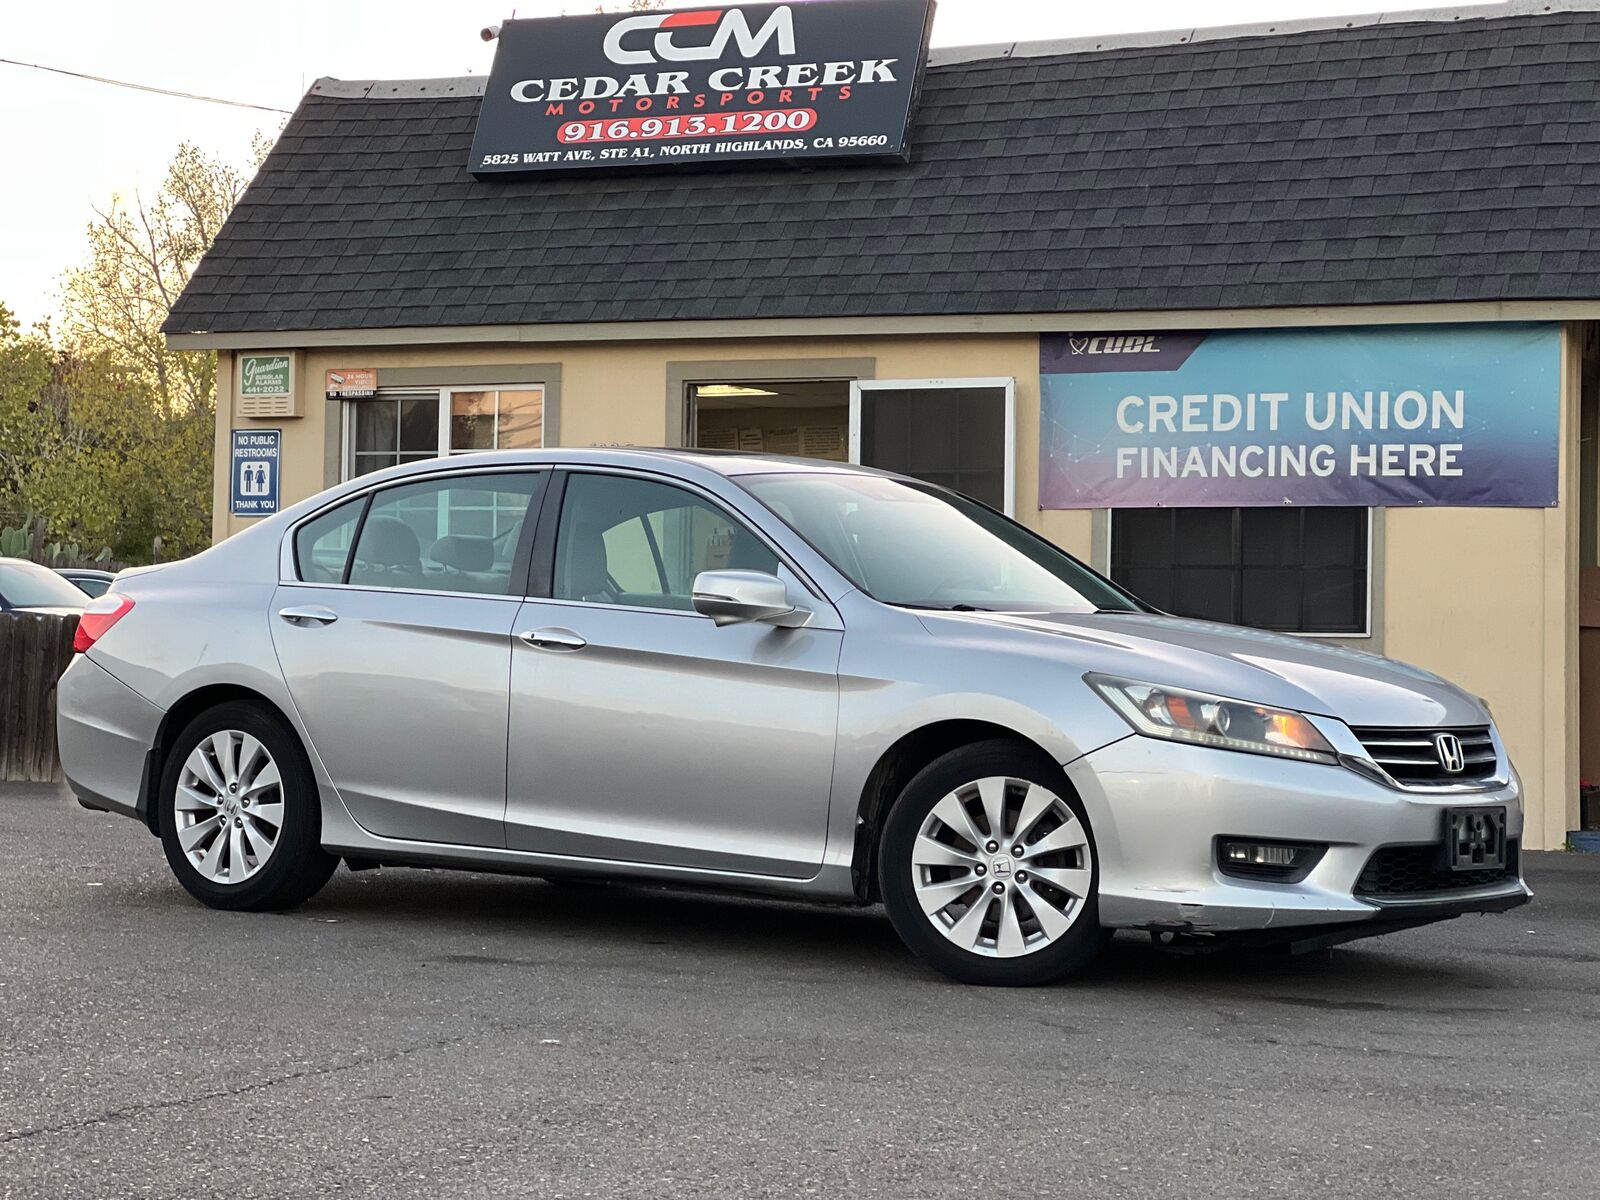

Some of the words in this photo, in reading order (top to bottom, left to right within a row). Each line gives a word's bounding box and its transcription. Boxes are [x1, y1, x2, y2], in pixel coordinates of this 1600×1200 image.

[510, 72, 690, 102] CEDAR
[708, 59, 898, 91] CREEK
[545, 86, 852, 116] MOTORSPORTS
[564, 110, 810, 141] 916.913.1200
[482, 154, 518, 165] 5825
[523, 151, 562, 163] WATT
[563, 150, 595, 161] AVE,
[600, 148, 628, 159] STE
[632, 147, 655, 158] A1,
[660, 143, 710, 156] NORTH
[715, 138, 808, 153] HIGHLANDS,
[813, 137, 833, 148] CA
[838, 135, 887, 147] 95660
[244, 358, 288, 386] Guardian
[1116, 393, 1288, 434] CREDIT
[1305, 390, 1464, 430] UNION
[234, 448, 277, 457] RESTROOMS
[238, 436, 249, 445] NO
[250, 435, 275, 445] PUBLIC
[1116, 445, 1336, 478] FINANCING
[1350, 444, 1463, 477] HERE
[235, 500, 258, 509] THANK
[259, 500, 275, 508] YOU
